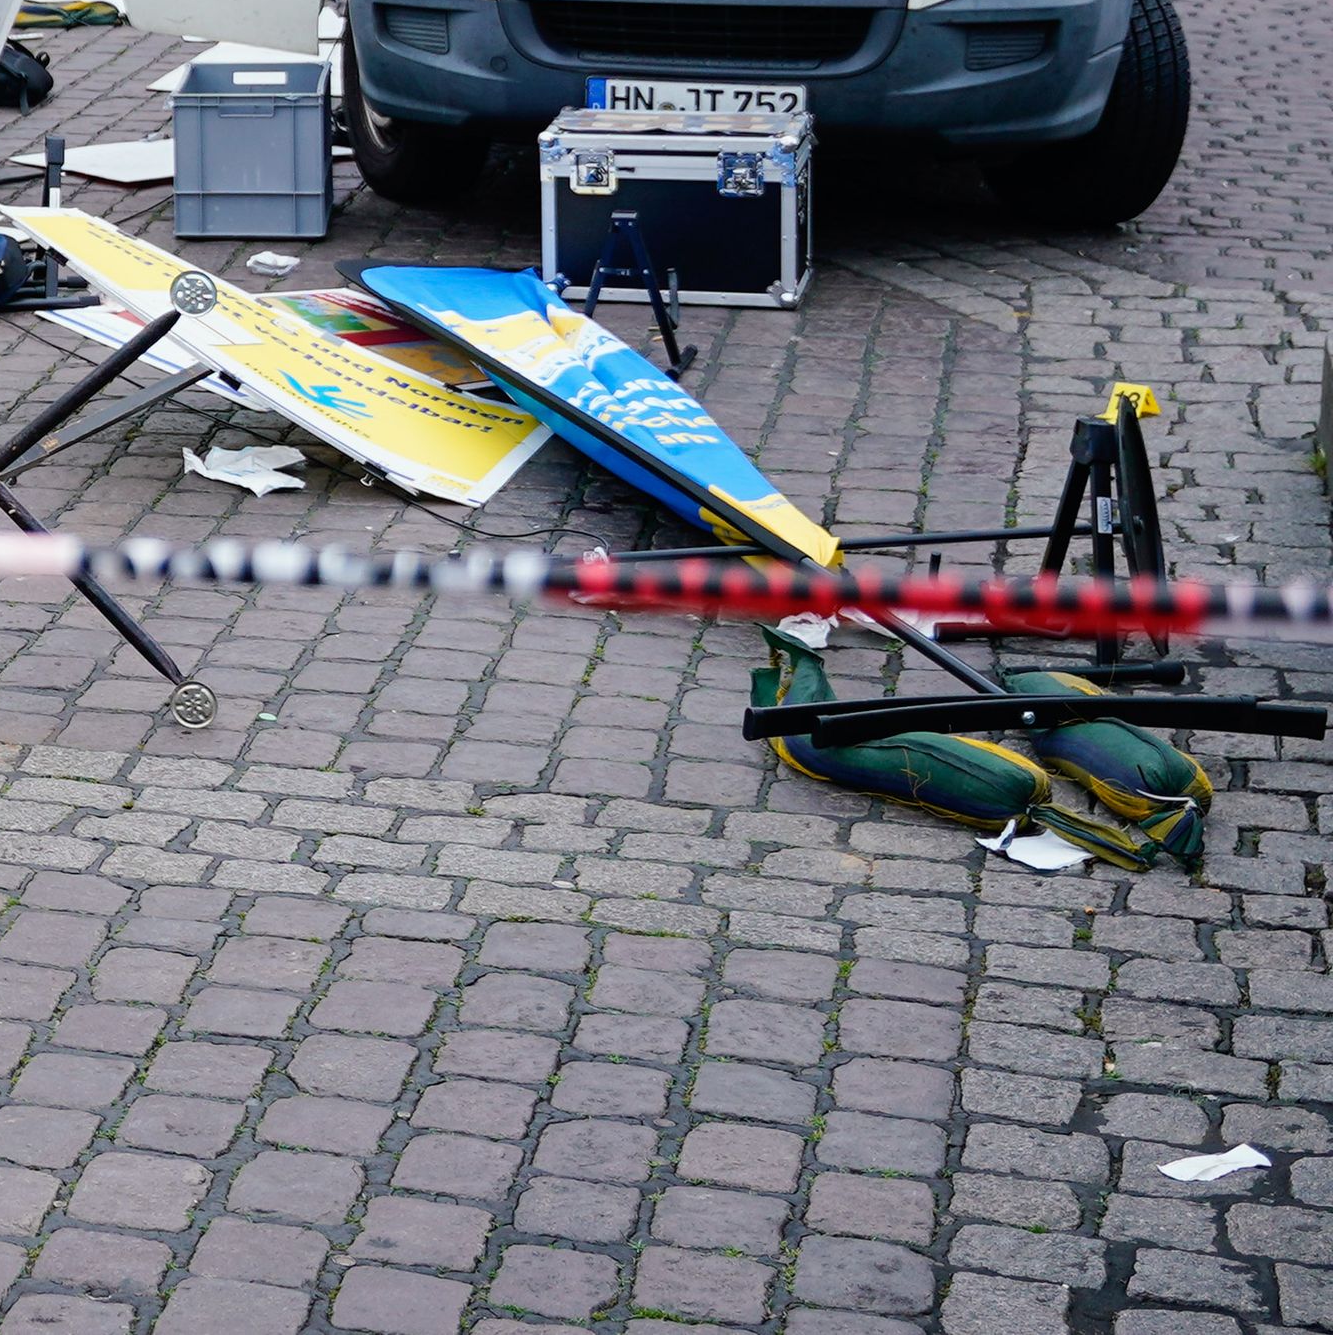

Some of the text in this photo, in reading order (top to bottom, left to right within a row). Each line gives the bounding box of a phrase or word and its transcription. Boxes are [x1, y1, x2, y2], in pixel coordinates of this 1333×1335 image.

[610, 85, 655, 111] HN
[254, 324, 494, 434] verhandelbar!
[384, 375, 525, 427] Normen
